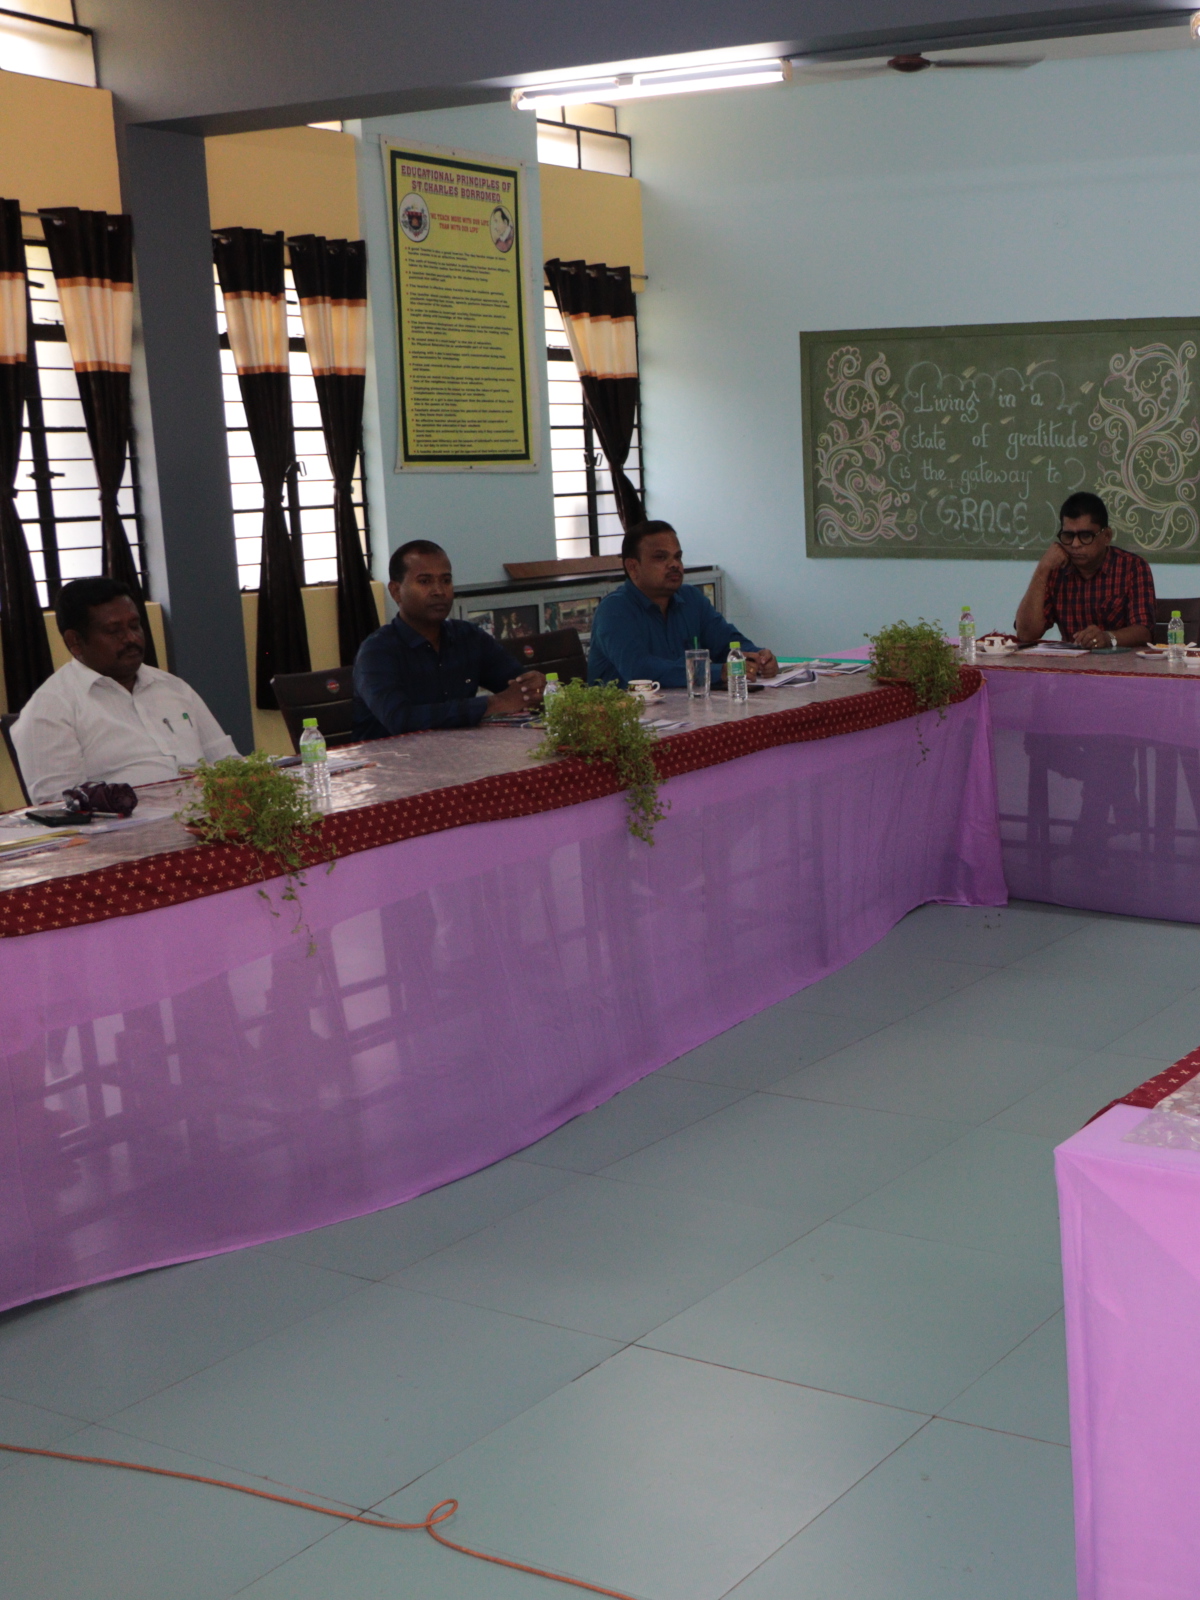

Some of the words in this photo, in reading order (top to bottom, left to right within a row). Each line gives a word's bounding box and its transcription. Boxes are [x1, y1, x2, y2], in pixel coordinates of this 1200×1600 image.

[401, 165, 455, 182] EDUCATIONAL
[456, 174, 500, 190] PRINCIPLES
[501, 181, 512, 192] OF
[914, 383, 980, 423] Living
[998, 388, 1016, 408] in
[1030, 393, 1044, 407] a
[911, 423, 946, 450] state
[972, 423, 991, 448] of
[1006, 418, 1089, 460] gratitude
[899, 462, 911, 479] is
[922, 458, 947, 481] the
[960, 456, 1033, 500] gateway
[1046, 459, 1062, 484] to
[936, 494, 1029, 535] GRACE
